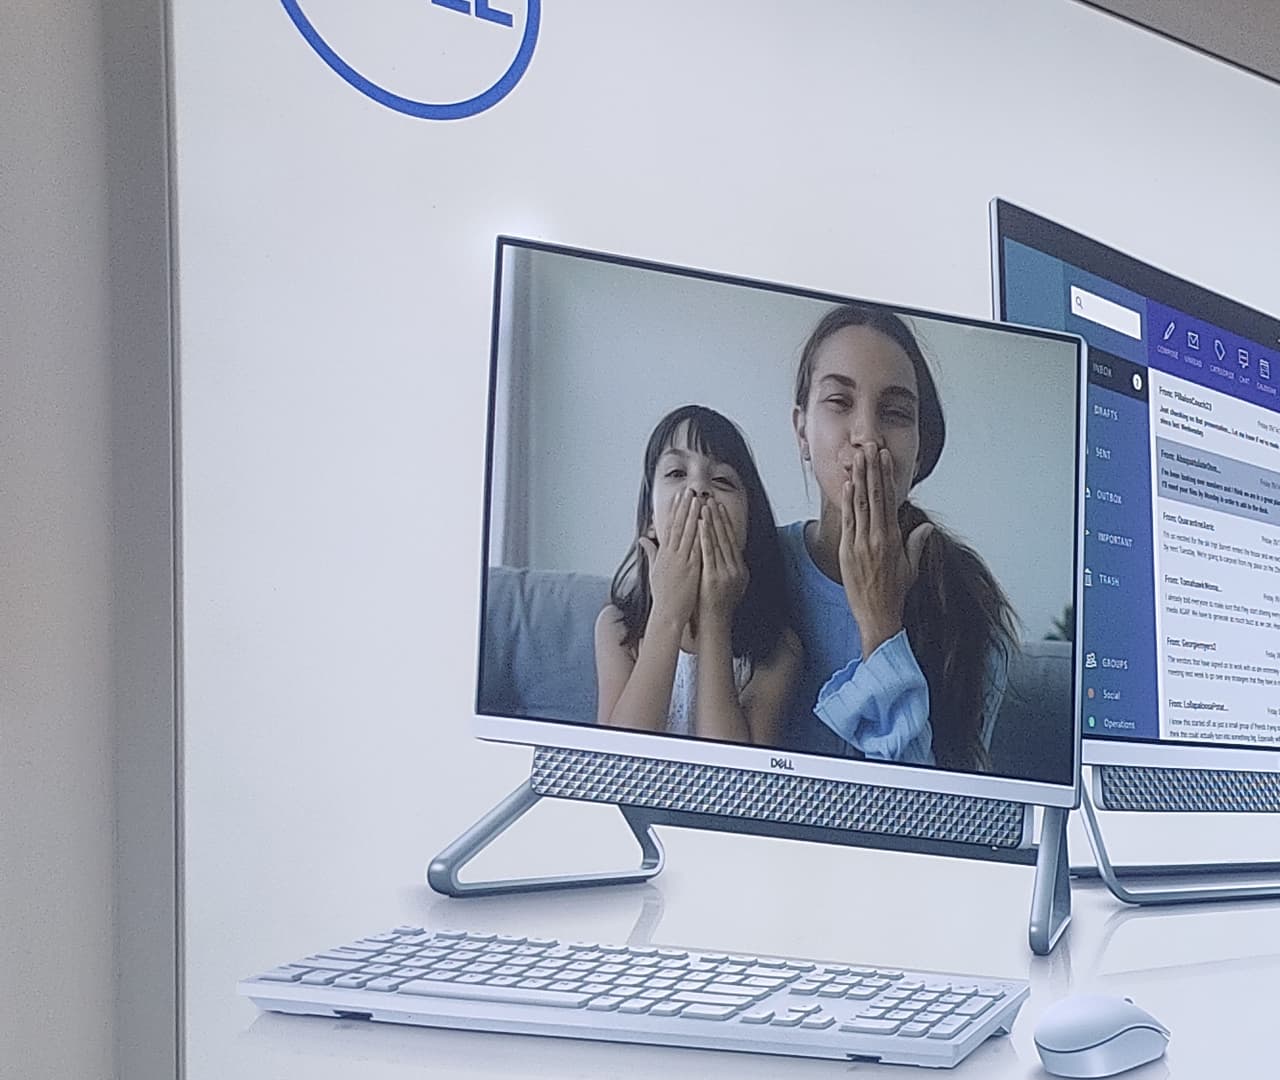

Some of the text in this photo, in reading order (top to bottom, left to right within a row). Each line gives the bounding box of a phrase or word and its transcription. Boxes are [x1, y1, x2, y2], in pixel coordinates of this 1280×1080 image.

[1093, 405, 1119, 421] DRAFTS
[1095, 447, 1111, 460] SENT
[1097, 490, 1122, 505] OUTBOX
[1098, 532, 1133, 549] IMPORTANT
[1099, 574, 1120, 587] TRASH
[1102, 657, 1128, 670] GROUPS
[1103, 689, 1121, 700] Social
[1104, 718, 1136, 730] Operations
[771, 758, 794, 771] DELL
